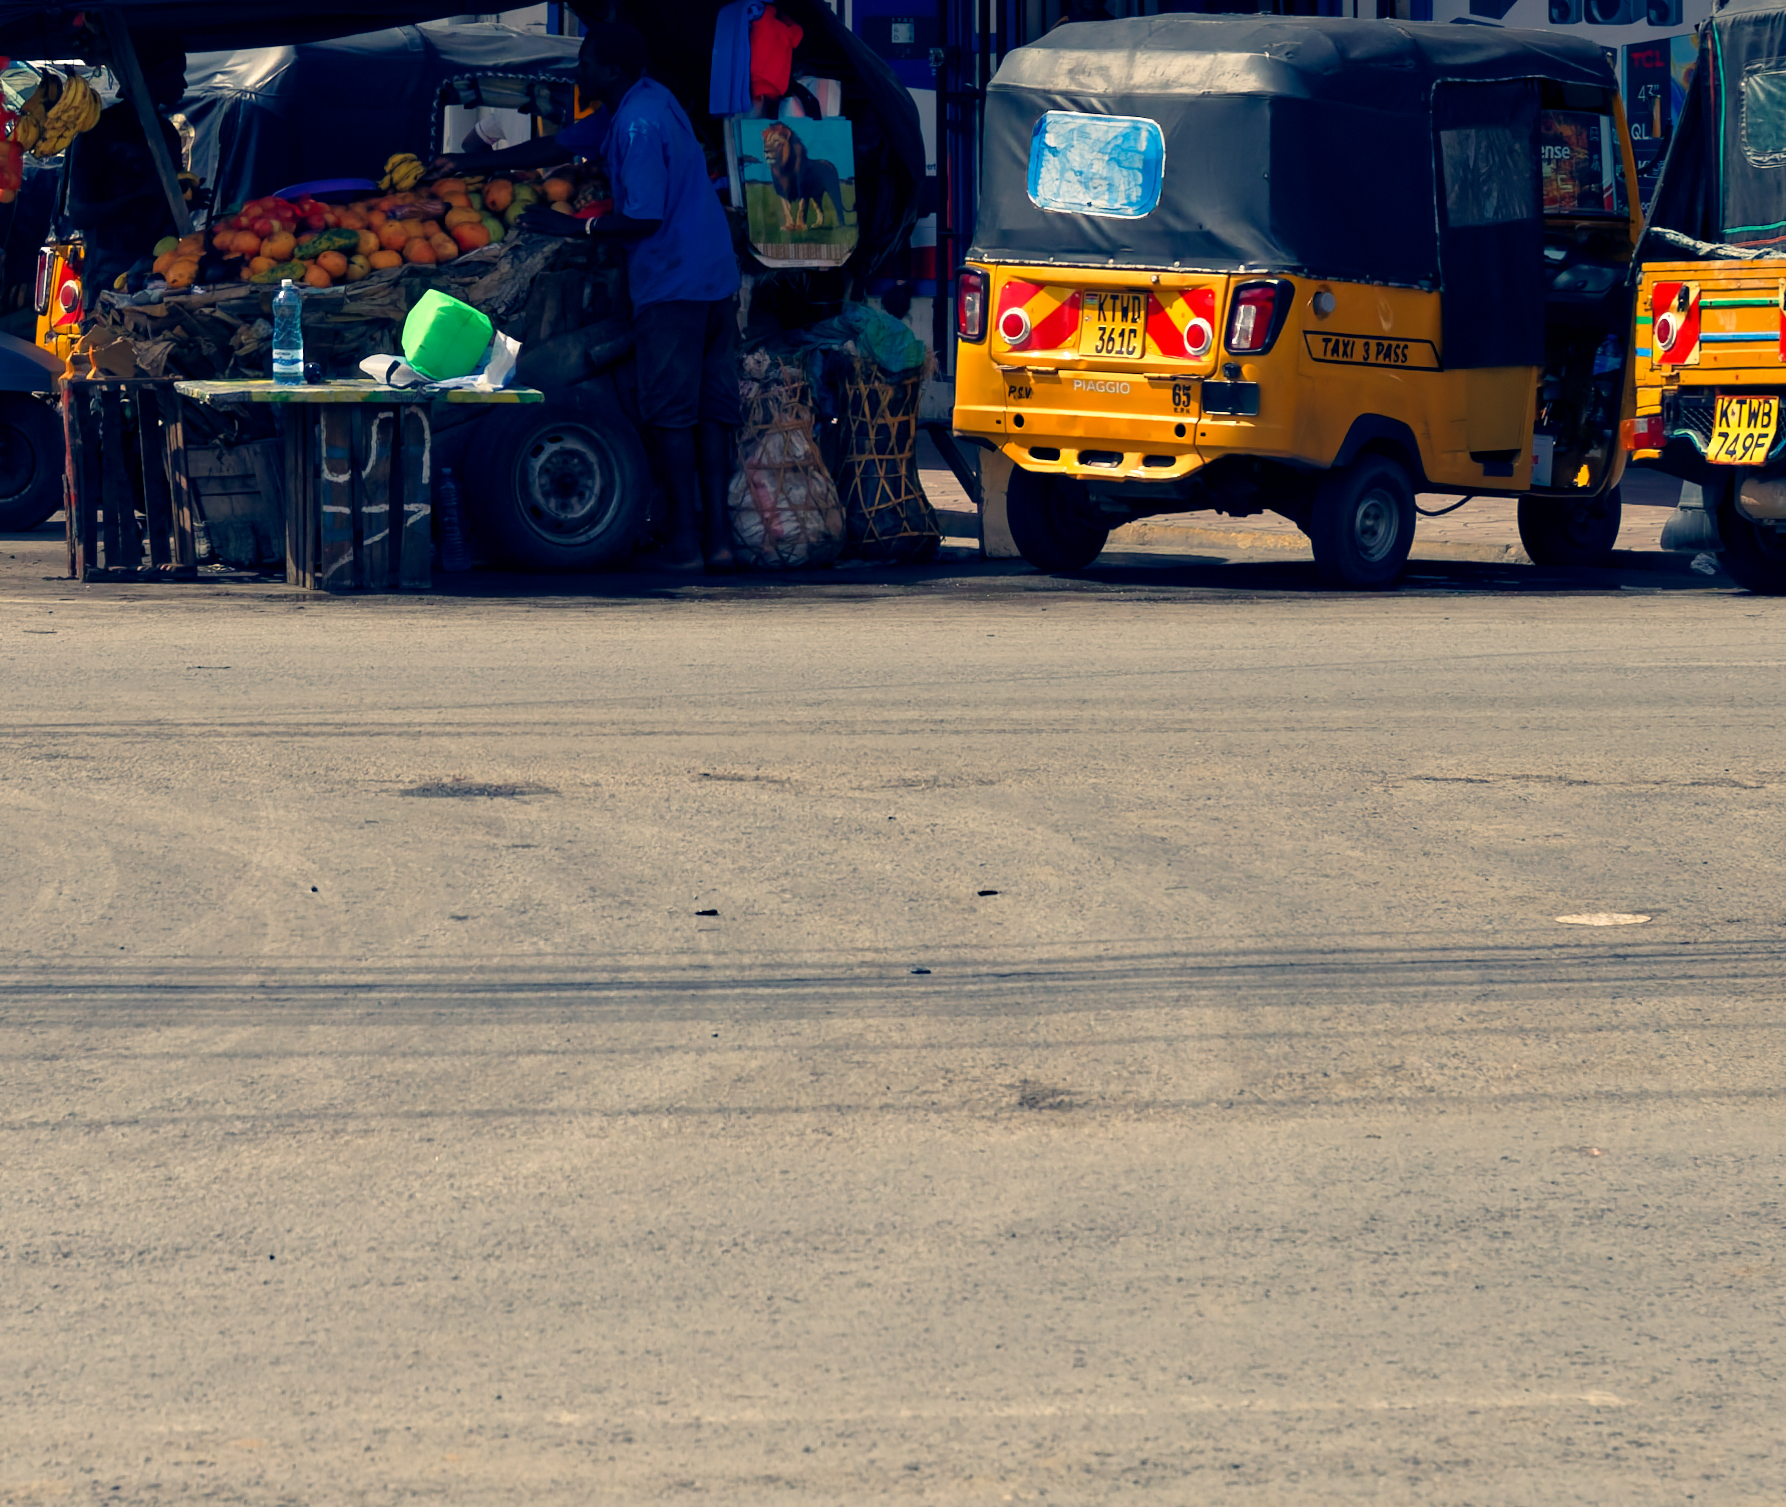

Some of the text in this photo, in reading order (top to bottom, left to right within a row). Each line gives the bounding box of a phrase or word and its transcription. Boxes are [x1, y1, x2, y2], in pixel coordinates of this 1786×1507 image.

[1630, 50, 1666, 68] TCL
[1097, 293, 1141, 324] KTWD
[1096, 326, 1137, 355] 361C
[1322, 337, 1409, 364] TAXI 3 PASS
[1073, 378, 1131, 395] PIAGGIO
[1172, 383, 1191, 408] 65
[1717, 398, 1773, 429] KTWB
[1713, 432, 1769, 461] 749F
